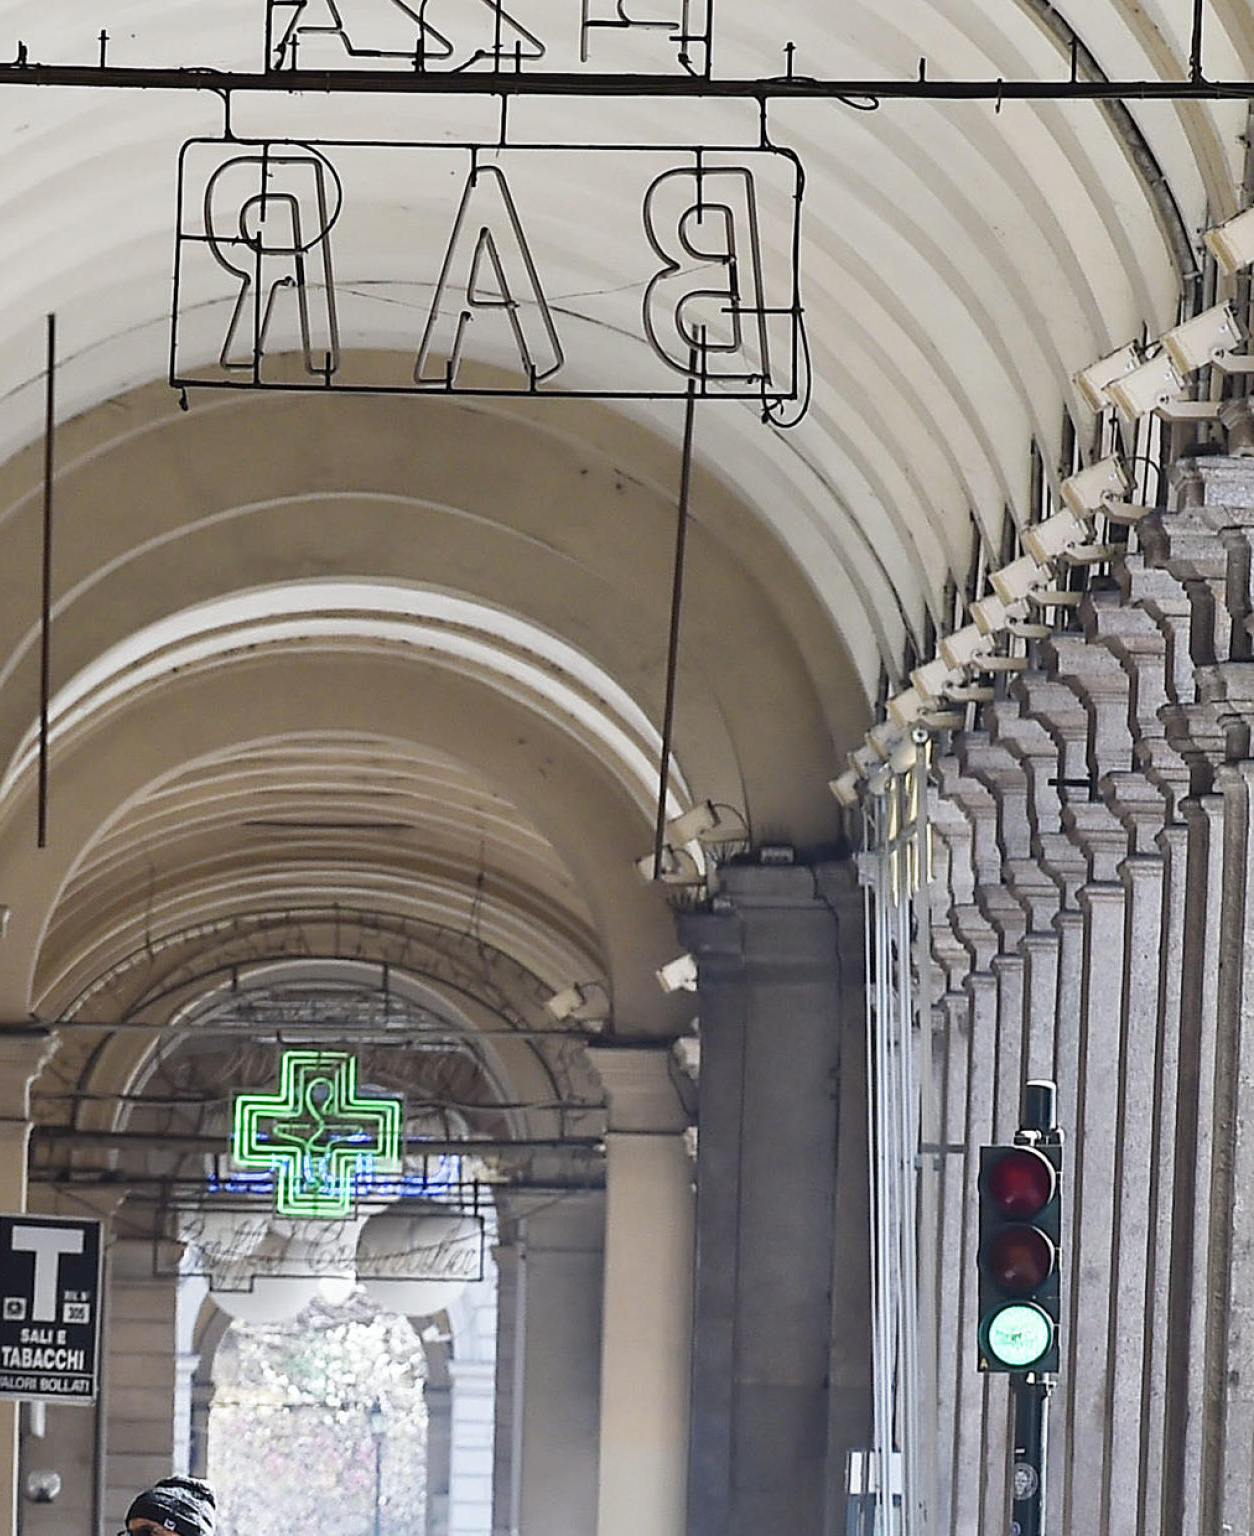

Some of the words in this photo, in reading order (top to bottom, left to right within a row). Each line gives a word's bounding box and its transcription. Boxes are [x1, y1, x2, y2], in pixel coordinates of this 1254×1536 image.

[12, 1225, 84, 1322] T
[20, 1328, 53, 1344] SALI
[57, 1330, 66, 1345] E
[2, 1346, 84, 1370] TABACCHI
[40, 1377, 89, 1393] BOLLATI
